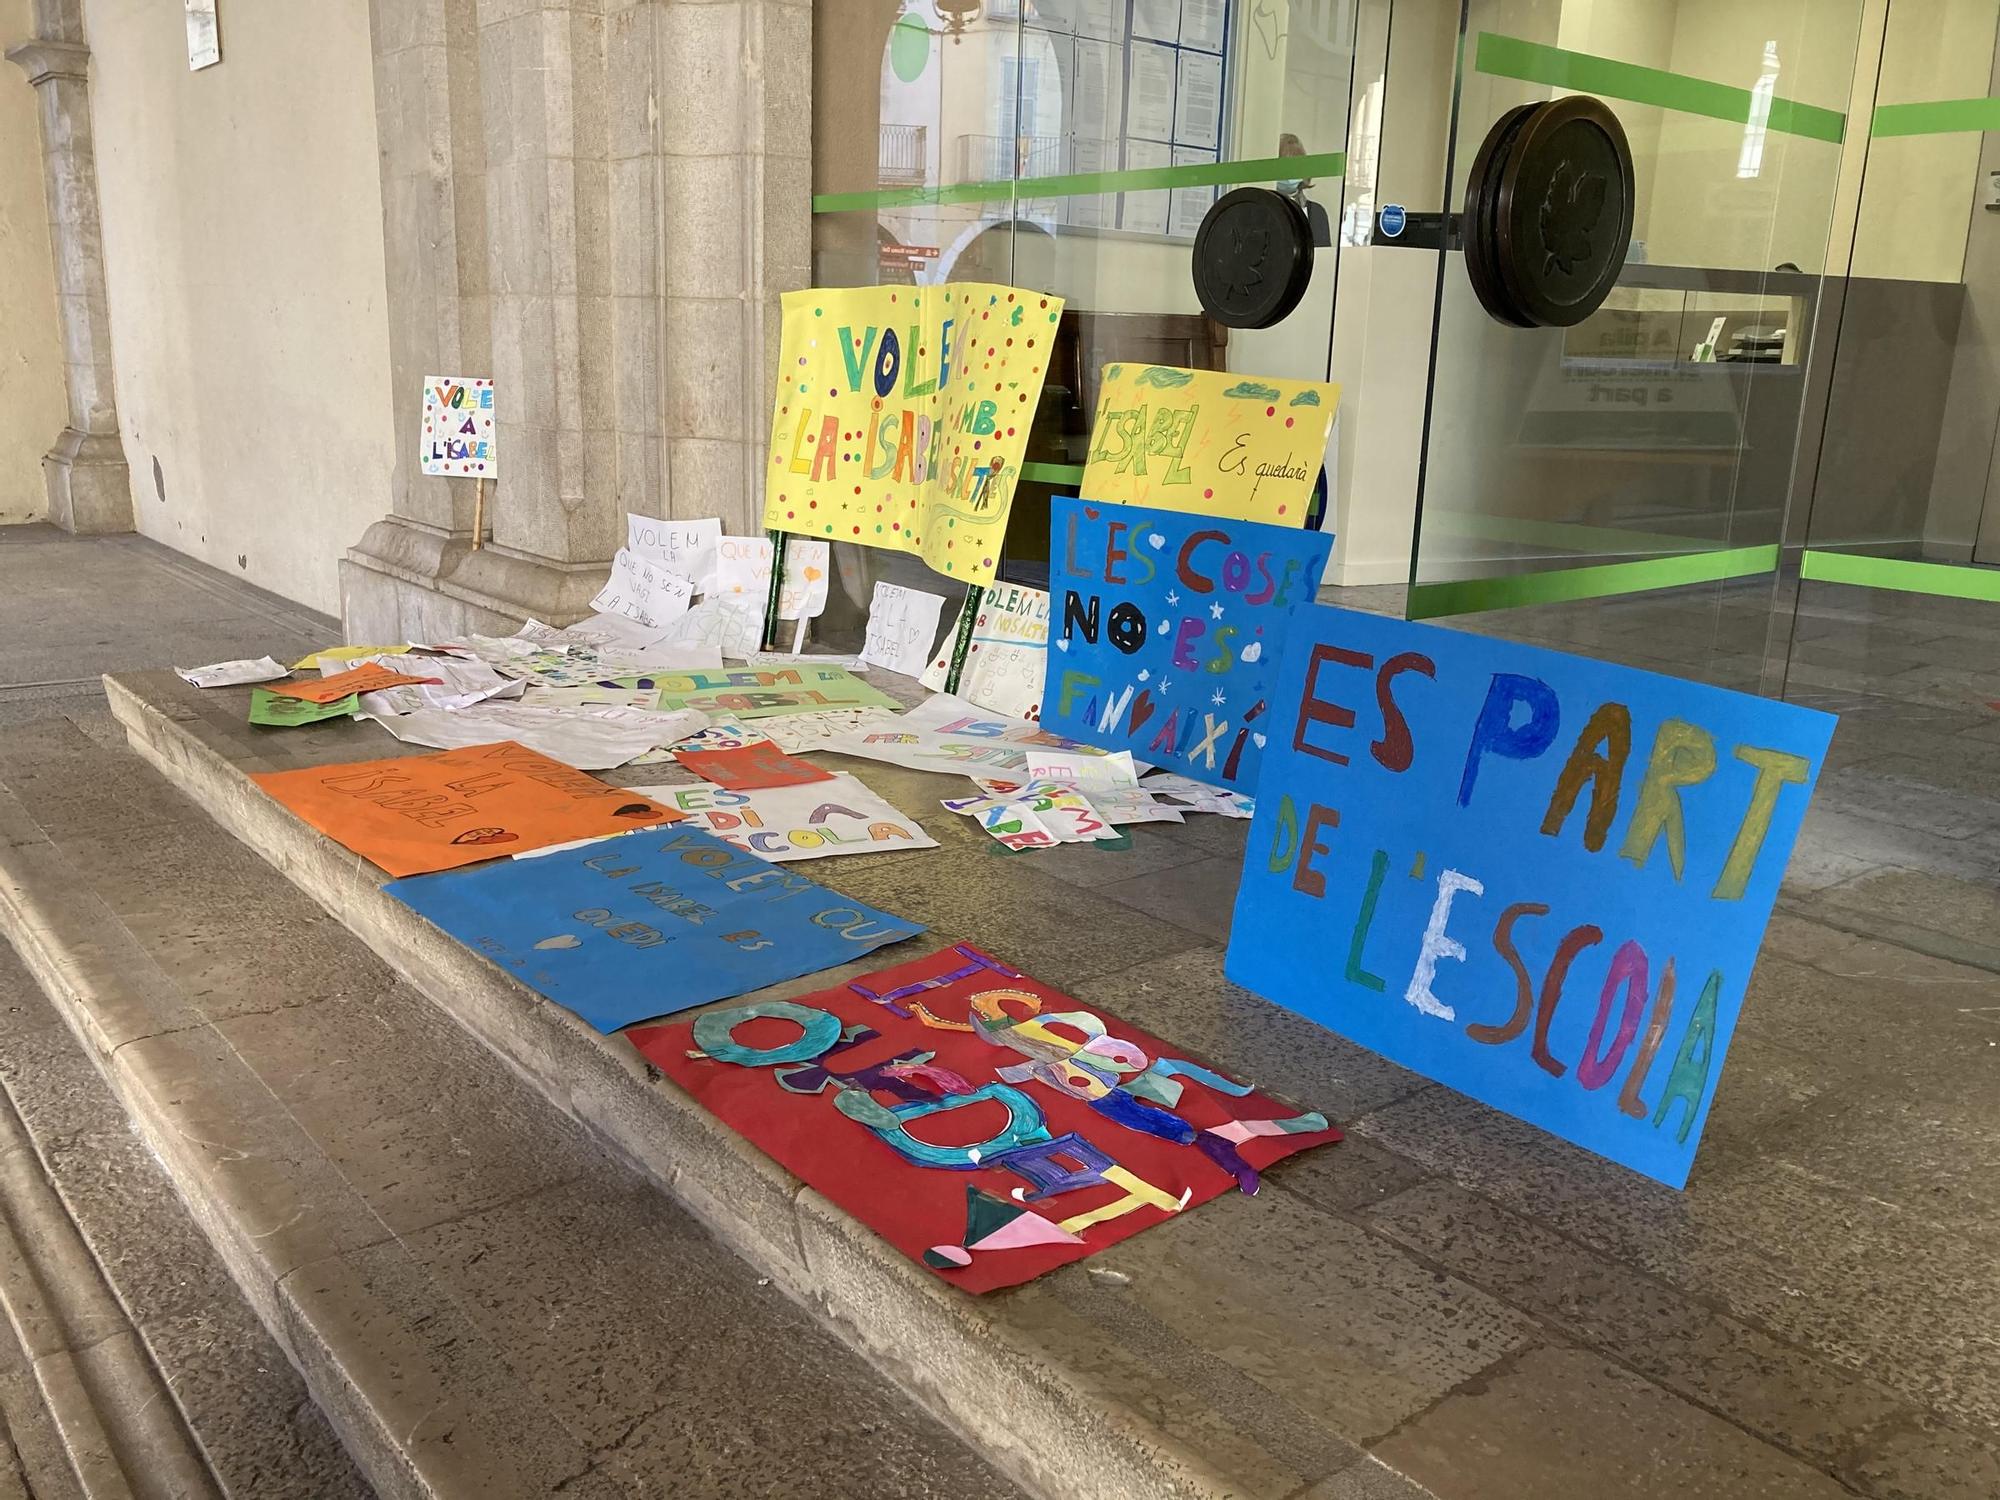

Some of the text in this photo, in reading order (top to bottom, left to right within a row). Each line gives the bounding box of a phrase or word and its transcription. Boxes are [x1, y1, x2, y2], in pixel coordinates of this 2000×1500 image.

[459, 416, 476, 435] A
[1218, 433, 1308, 501] Es quedarà
[632, 529, 699, 551] VOLEM
[720, 541, 752, 561] QUE
[619, 551, 638, 577] QUE
[642, 568, 655, 585] NO
[984, 588, 1034, 616] OLEM
[1064, 590, 1239, 674] NO ES
[445, 770, 515, 799] LA
[1292, 642, 1810, 901] ES PART
[1268, 794, 1341, 898] DE
